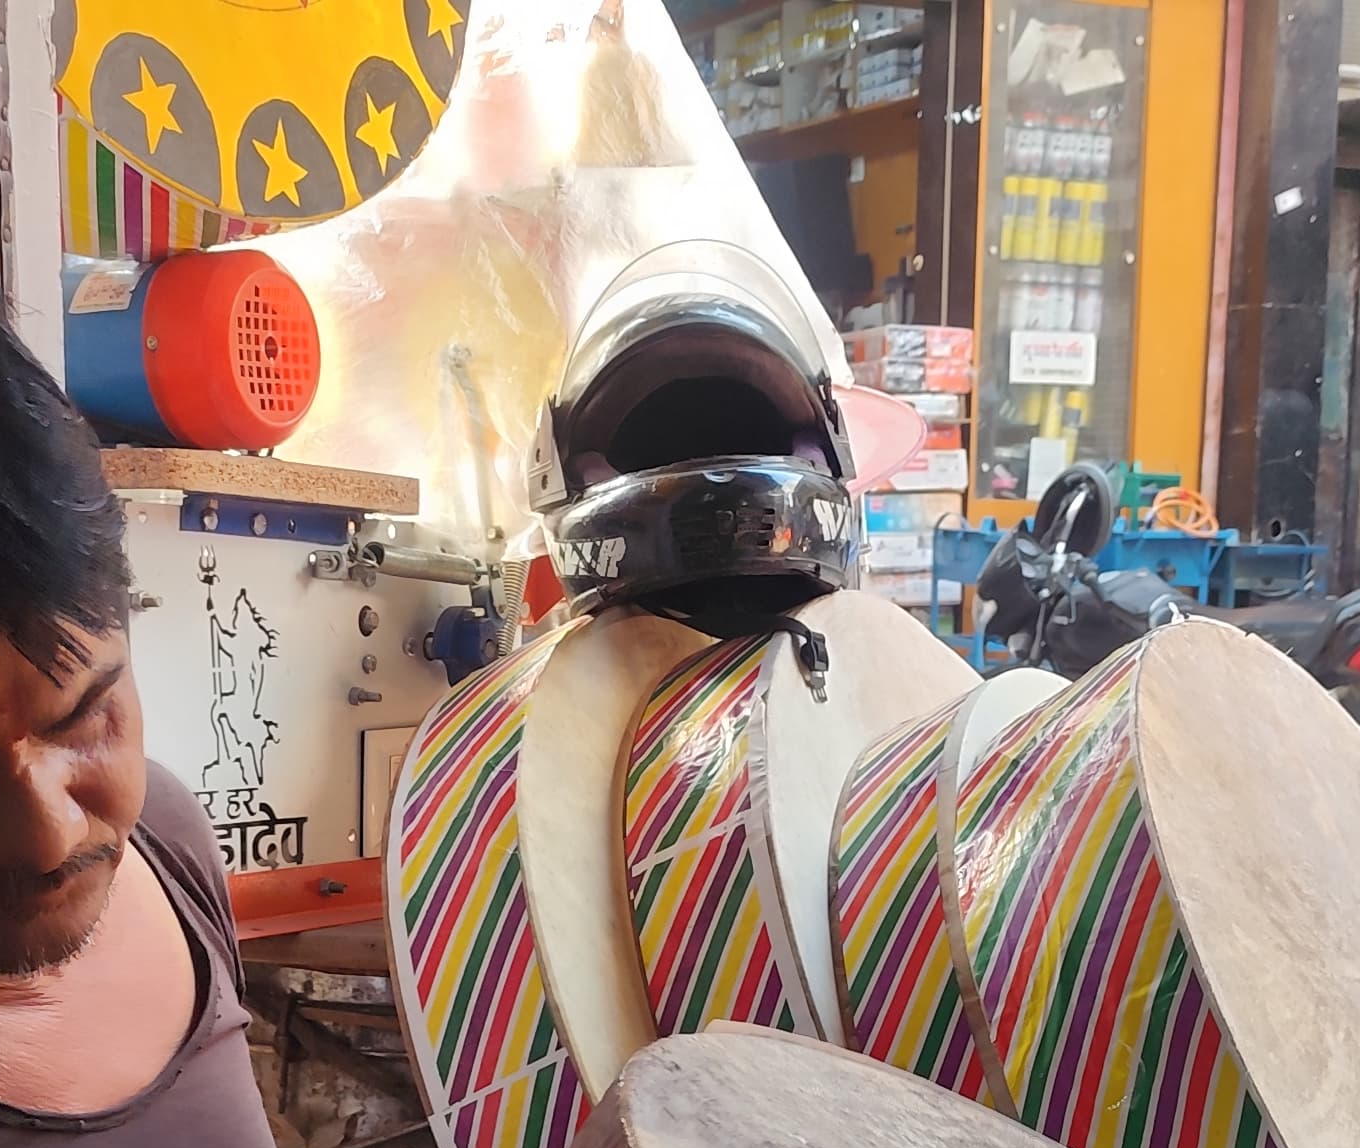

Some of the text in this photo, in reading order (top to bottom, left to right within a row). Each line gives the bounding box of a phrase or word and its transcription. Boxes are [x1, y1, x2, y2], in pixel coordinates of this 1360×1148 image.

[193, 787, 259, 819] र हर
[212, 802, 308, 871] हादेव
